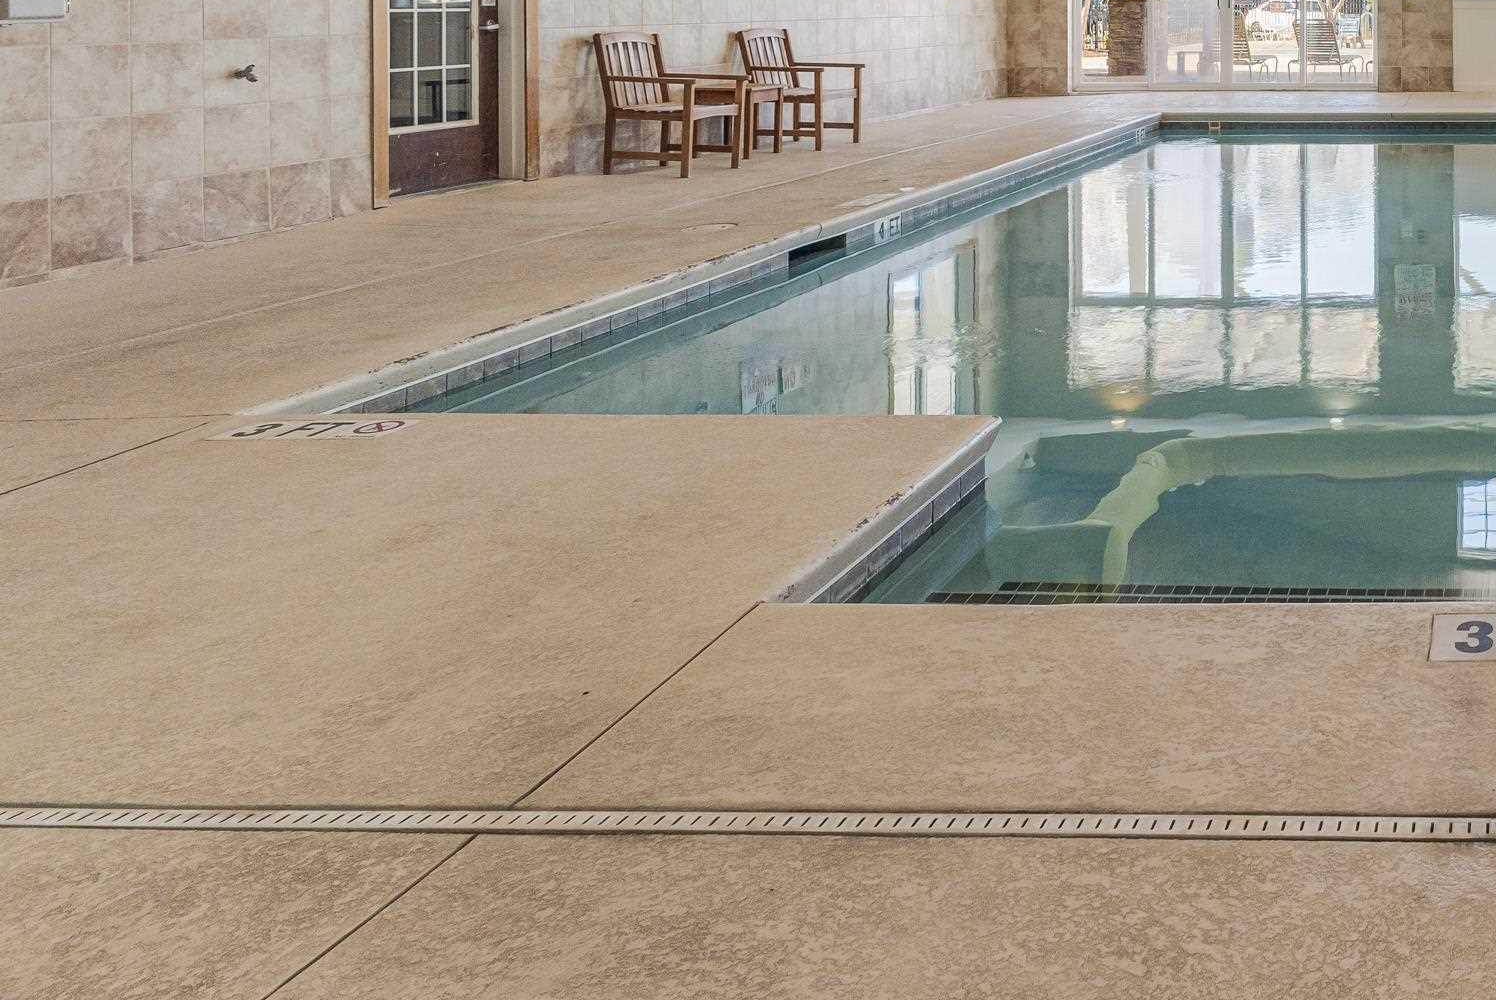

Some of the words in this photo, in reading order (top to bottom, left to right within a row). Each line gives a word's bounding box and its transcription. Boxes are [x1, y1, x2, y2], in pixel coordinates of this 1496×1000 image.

[231, 423, 284, 438] 3
[274, 421, 356, 438] FT
[1454, 620, 1495, 654] 3
